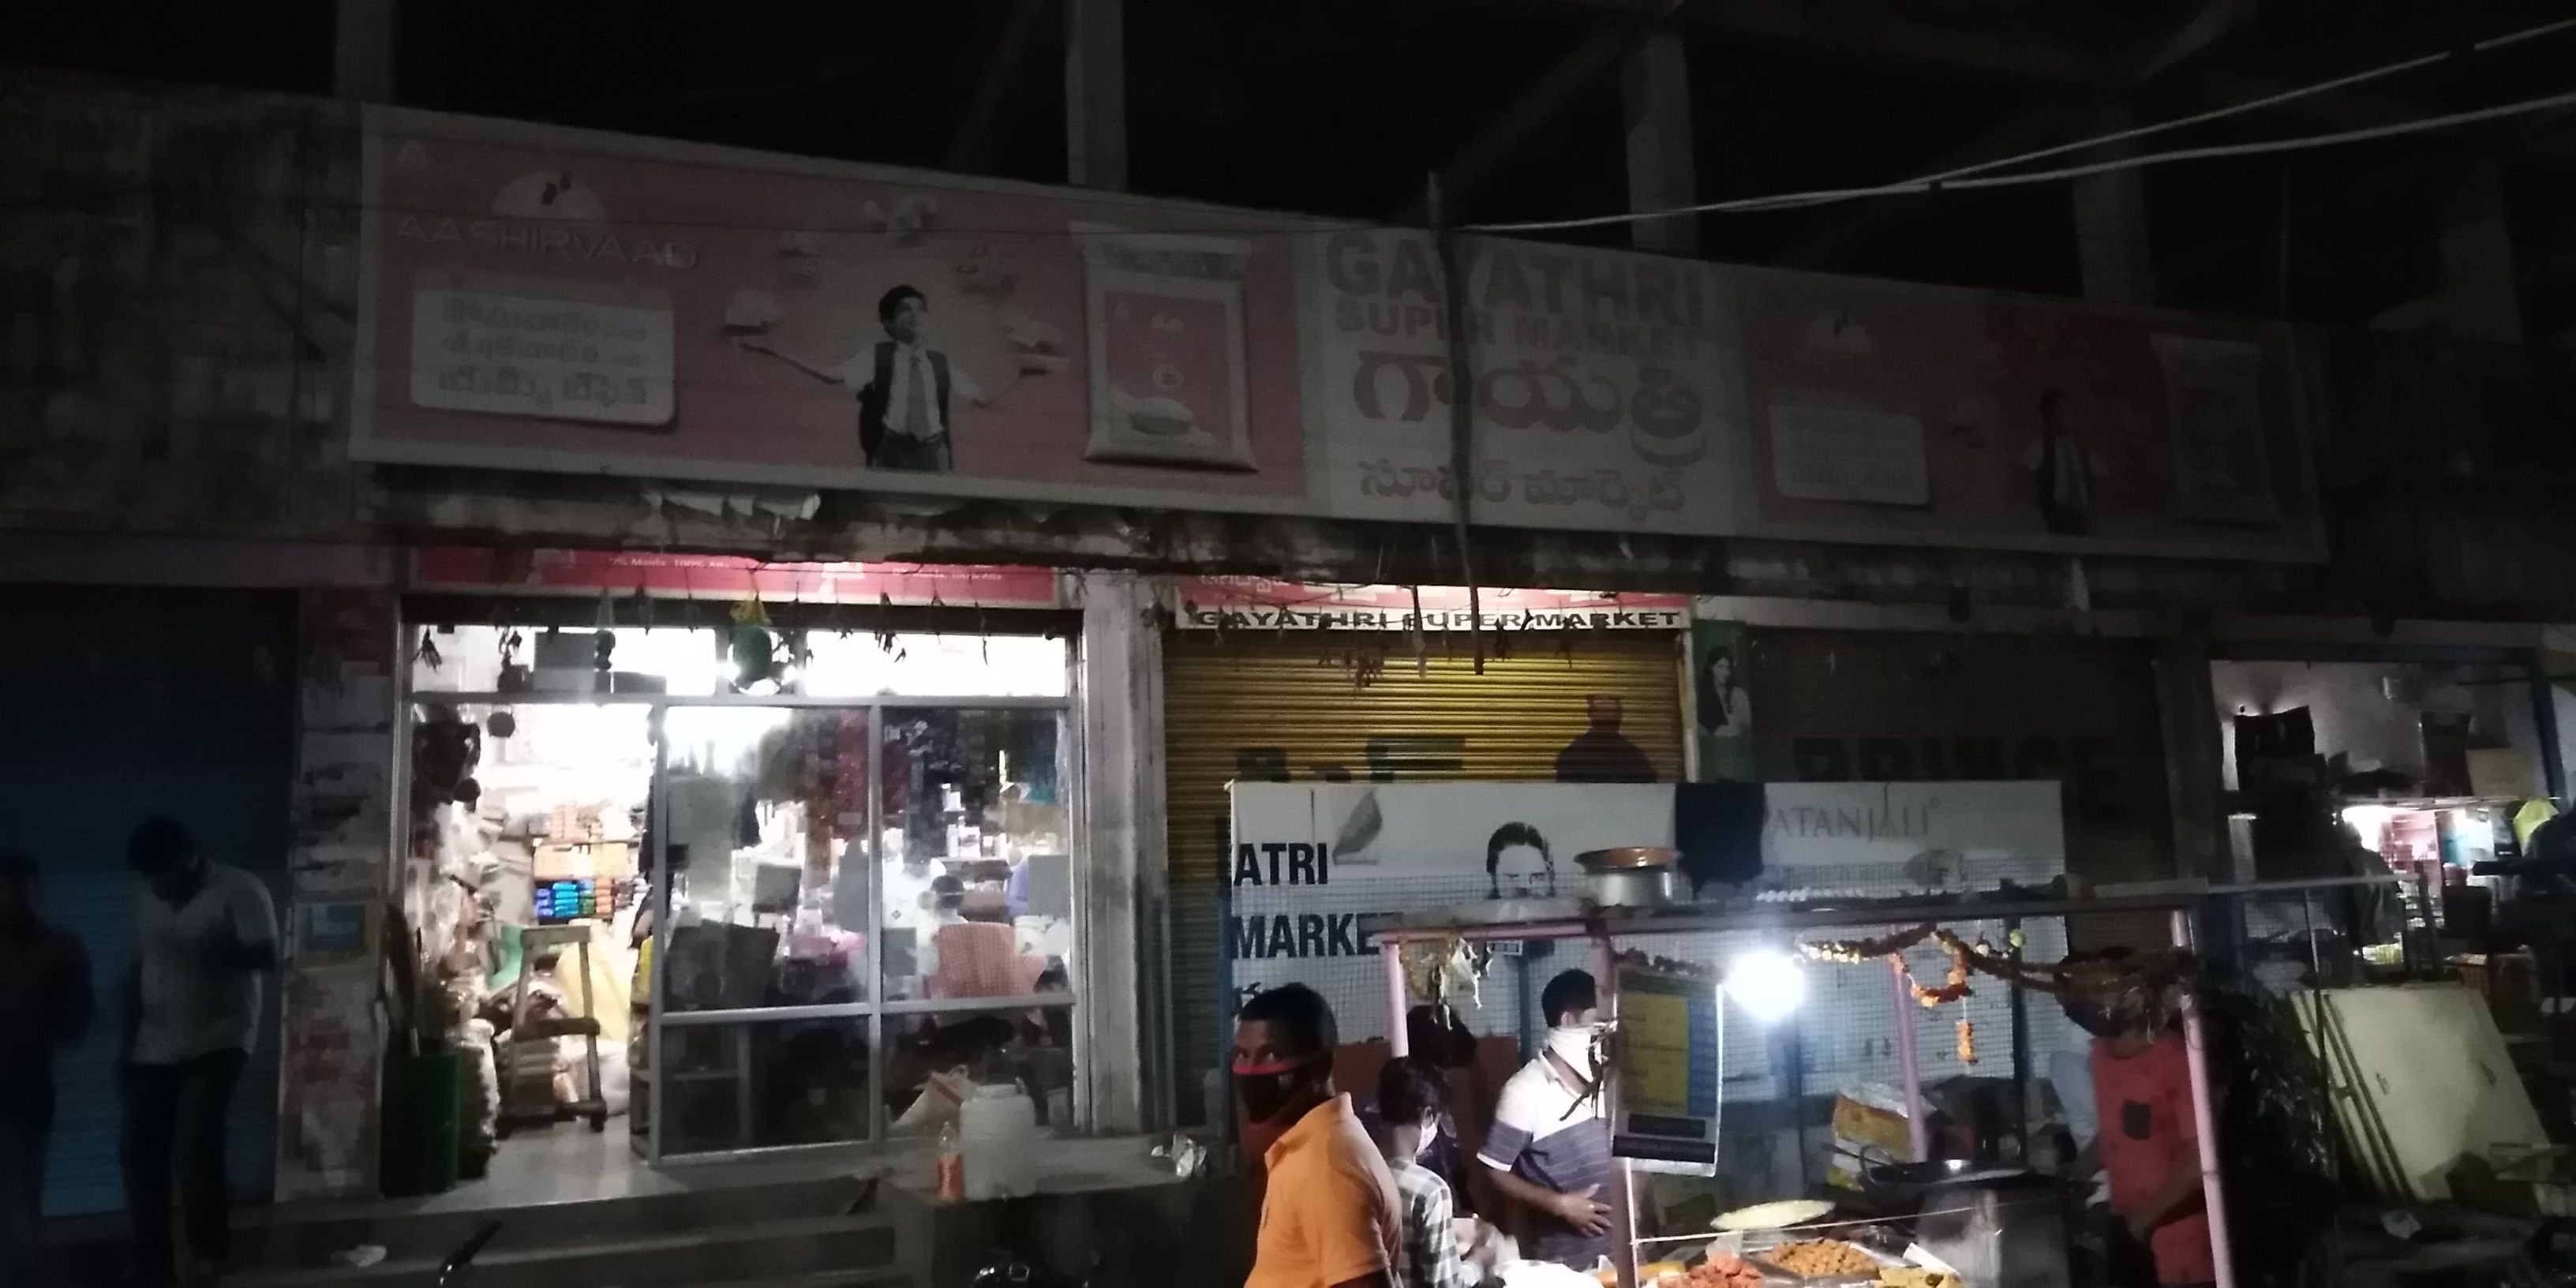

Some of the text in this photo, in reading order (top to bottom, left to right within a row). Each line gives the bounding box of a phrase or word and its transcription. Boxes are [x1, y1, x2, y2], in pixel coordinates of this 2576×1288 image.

[396, 213, 698, 269] AASHIRVAAD
[1326, 232, 1703, 328] GAYATHRI
[1514, 313, 1703, 361] MARKET
[1196, 611, 1387, 629] GAYATHRI
[1535, 612, 1681, 628] MARKET
[1765, 803, 1930, 843] ATANJALI
[1231, 912, 1403, 959] MARKE
